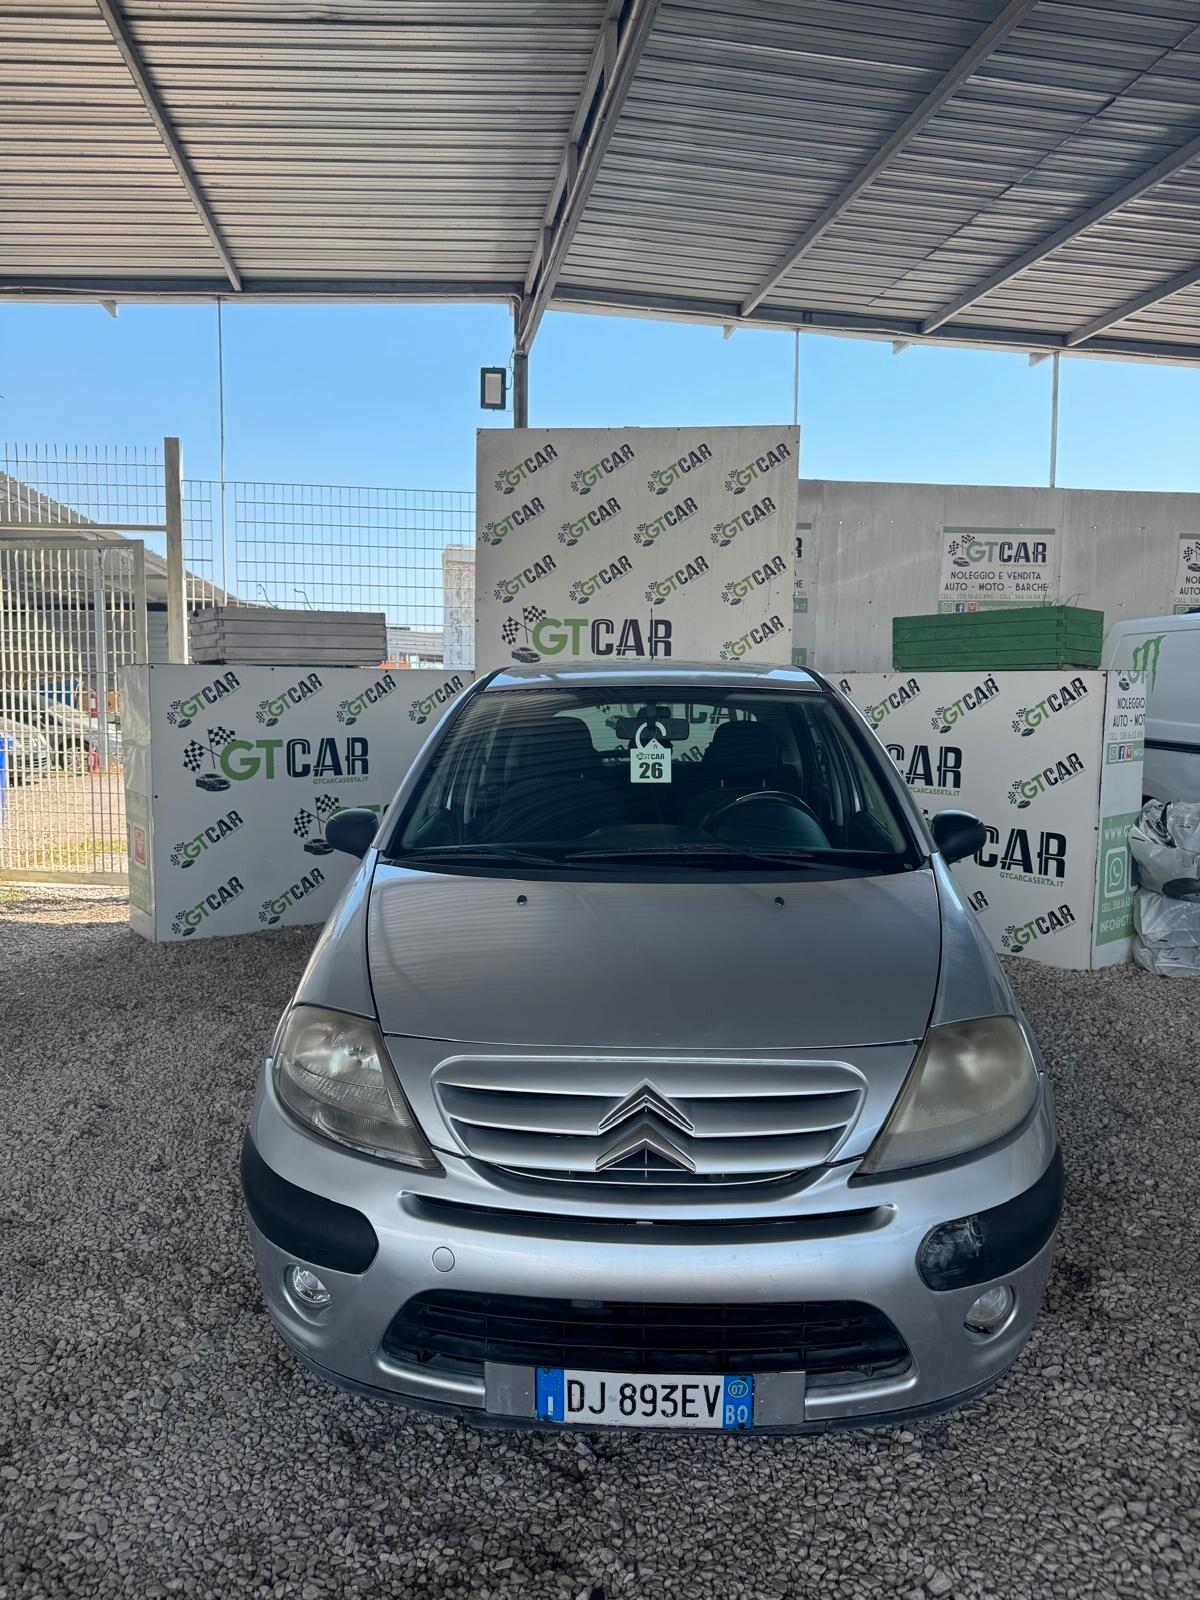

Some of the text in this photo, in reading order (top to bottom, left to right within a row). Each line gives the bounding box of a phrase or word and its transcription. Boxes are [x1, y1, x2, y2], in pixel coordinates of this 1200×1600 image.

[506, 444, 559, 487] GTCAR
[581, 444, 635, 487] GTCAR
[658, 443, 713, 487] GTCAR
[736, 443, 791, 487] GTCAR
[493, 497, 545, 538] GTCAR
[569, 497, 622, 538] GTCAR
[645, 496, 698, 539] GTCAR
[721, 496, 777, 539] GTCAR
[966, 542, 1047, 563] GTCAR
[505, 554, 557, 595] GTCAR
[580, 555, 633, 596] GTCAR
[656, 555, 709, 597] GTCAR
[732, 555, 787, 598] GTCAR
[944, 583, 968, 591] AUTO
[978, 583, 1005, 591] MOTO
[1015, 583, 1048, 592] BARCHE
[950, 571, 1042, 580] NOLEGGIO E VENDITA
[532, 618, 672, 656] GTCAR
[730, 615, 785, 657] GTCAR
[180, 671, 241, 719] GTCAR
[267, 672, 323, 719] GTCAR
[348, 674, 396, 717] GTCAR
[418, 675, 464, 716] GTCAR
[871, 677, 921, 723] GTCAR
[942, 677, 1000, 725] GTCAR
[1025, 677, 1088, 728] GTCAR
[1117, 697, 1145, 710] NOLEGGIO
[1113, 714, 1128, 728] AUTO
[1135, 713, 1146, 726] MOT
[220, 736, 369, 781] GTCAR
[639, 762, 663, 779] 26
[1021, 752, 1085, 799] GTCAR
[312, 776, 369, 785] GTCARCASERTA.IT
[909, 786, 961, 797] CARCASERTA.IT
[182, 810, 244, 861] GTCAR
[974, 825, 1067, 879] CAR
[270, 867, 325, 916] GTCAR
[1000, 871, 1065, 888] GTCARCASERTA.IT
[184, 876, 244, 928] GTCAR
[1014, 904, 1076, 947] GTCAR
[567, 1380, 606, 1414] DJ
[619, 1383, 721, 1418] 893EV
[731, 1384, 744, 1395] 07
[726, 1404, 748, 1425] BO
